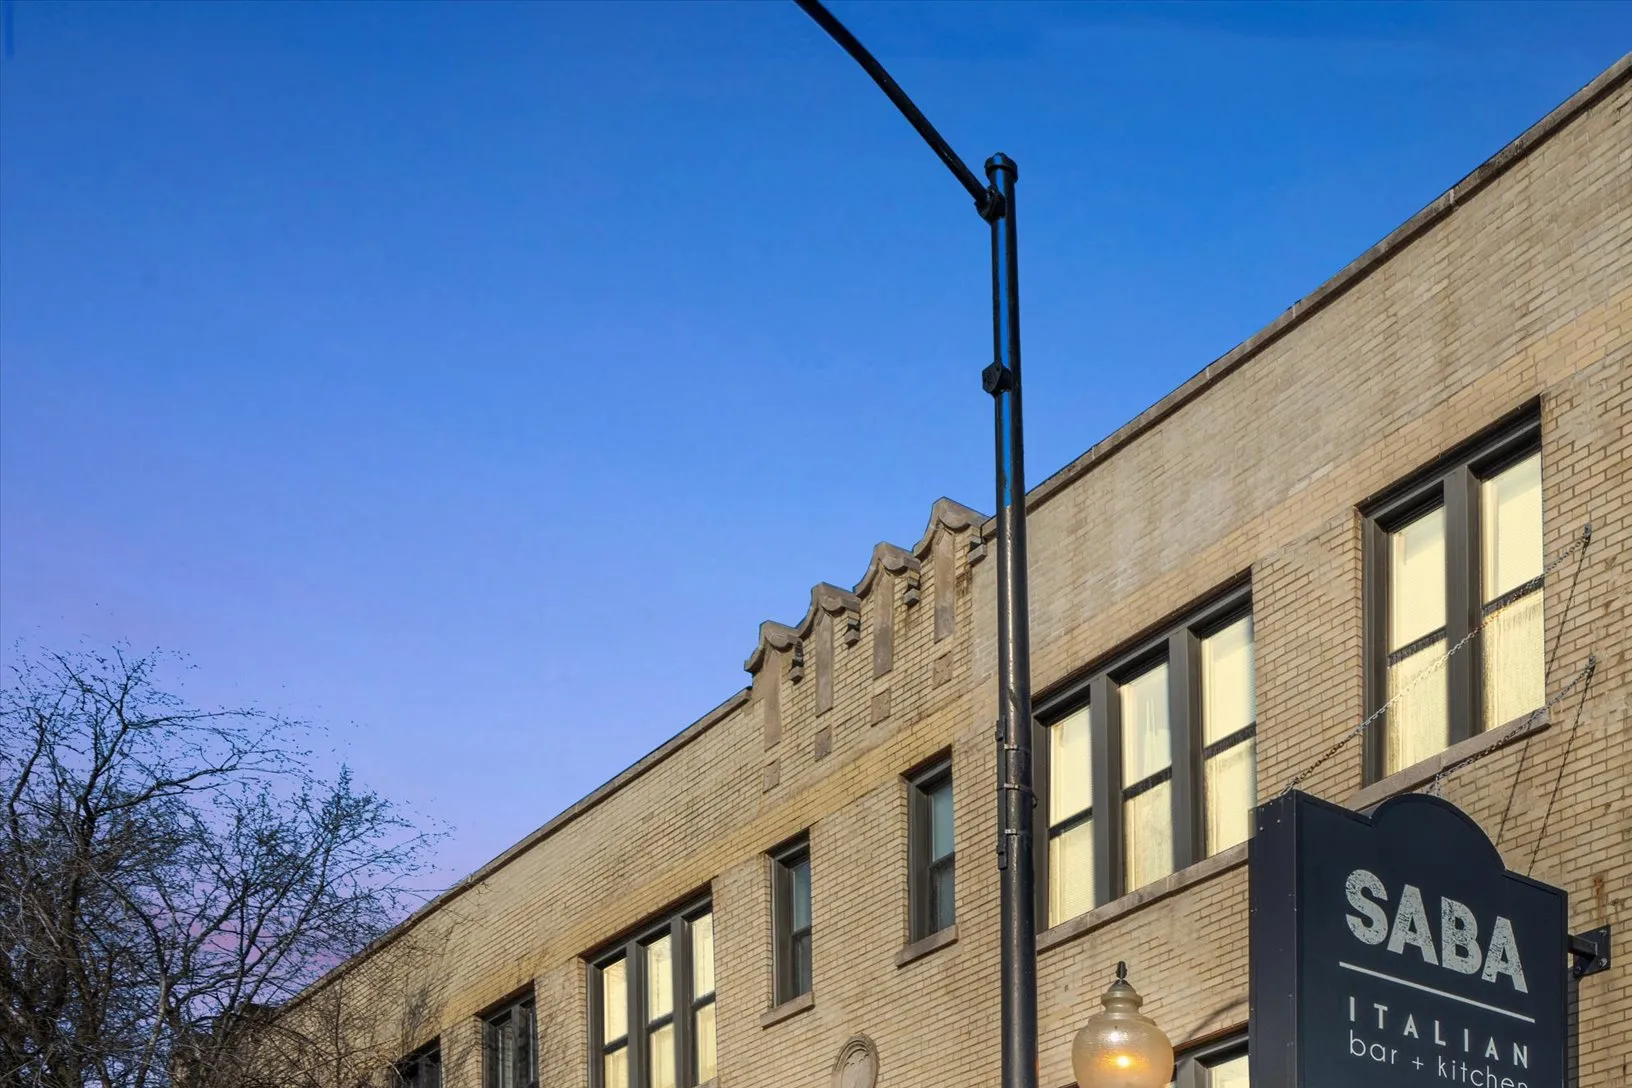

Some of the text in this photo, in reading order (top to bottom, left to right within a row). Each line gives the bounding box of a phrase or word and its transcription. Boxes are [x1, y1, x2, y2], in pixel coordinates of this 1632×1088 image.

[1345, 868, 1528, 994] SABA
[1349, 996, 1528, 1069] ITALIAN
[1349, 1030, 1398, 1065] bar
[1412, 1057, 1424, 1070] +
